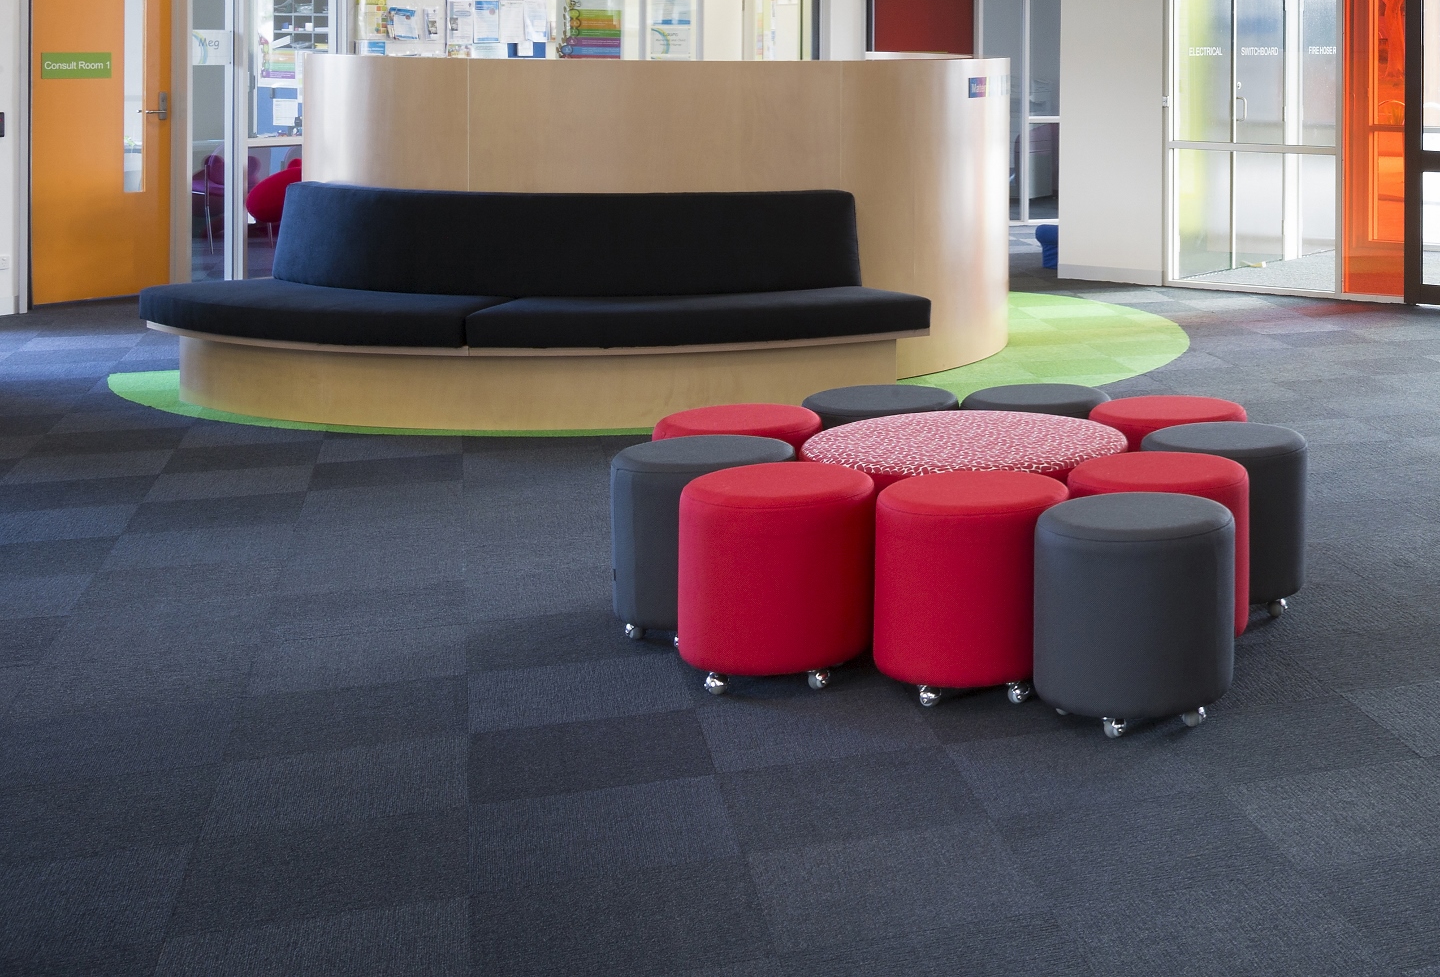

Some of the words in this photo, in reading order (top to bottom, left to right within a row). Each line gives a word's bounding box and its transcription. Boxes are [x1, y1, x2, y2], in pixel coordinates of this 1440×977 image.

[199, 38, 219, 50] Meg
[1189, 47, 1222, 56] ELECTRICAL
[1241, 47, 1278, 55] SWITCHBOARD
[44, 61, 76, 69] Consult
[78, 61, 103, 69] Room
[106, 61, 110, 69] 1
